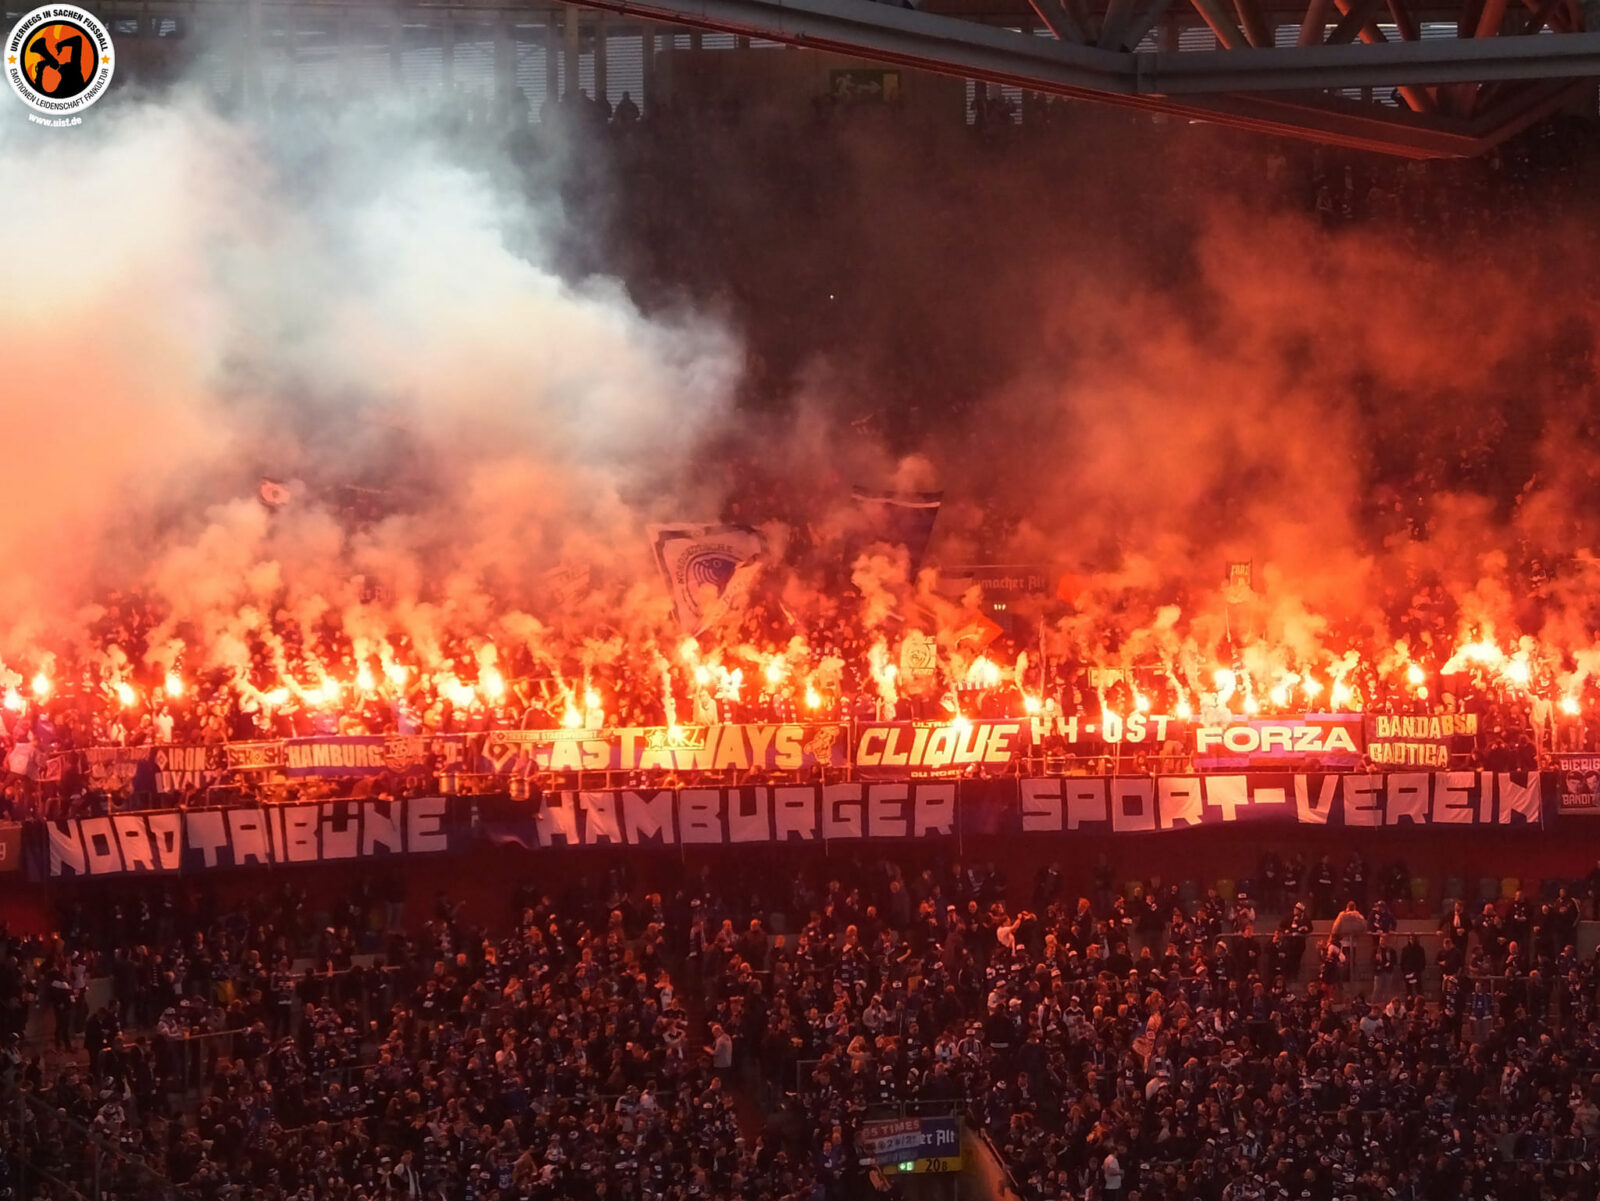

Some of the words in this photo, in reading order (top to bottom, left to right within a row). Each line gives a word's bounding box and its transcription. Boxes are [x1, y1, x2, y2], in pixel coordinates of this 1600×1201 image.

[1196, 726, 1357, 753] FORZA
[1376, 715, 1441, 739] BANDA
[168, 746, 206, 770] IRON
[535, 725, 804, 771] ASTAWAYS
[856, 724, 1020, 768] CLIQUE
[1368, 742, 1448, 768] CAOTICA
[534, 782, 956, 847] HAMBURGER
[1020, 771, 1542, 832] SPORT-VEREIN
[935, 1129, 955, 1147] Alt
